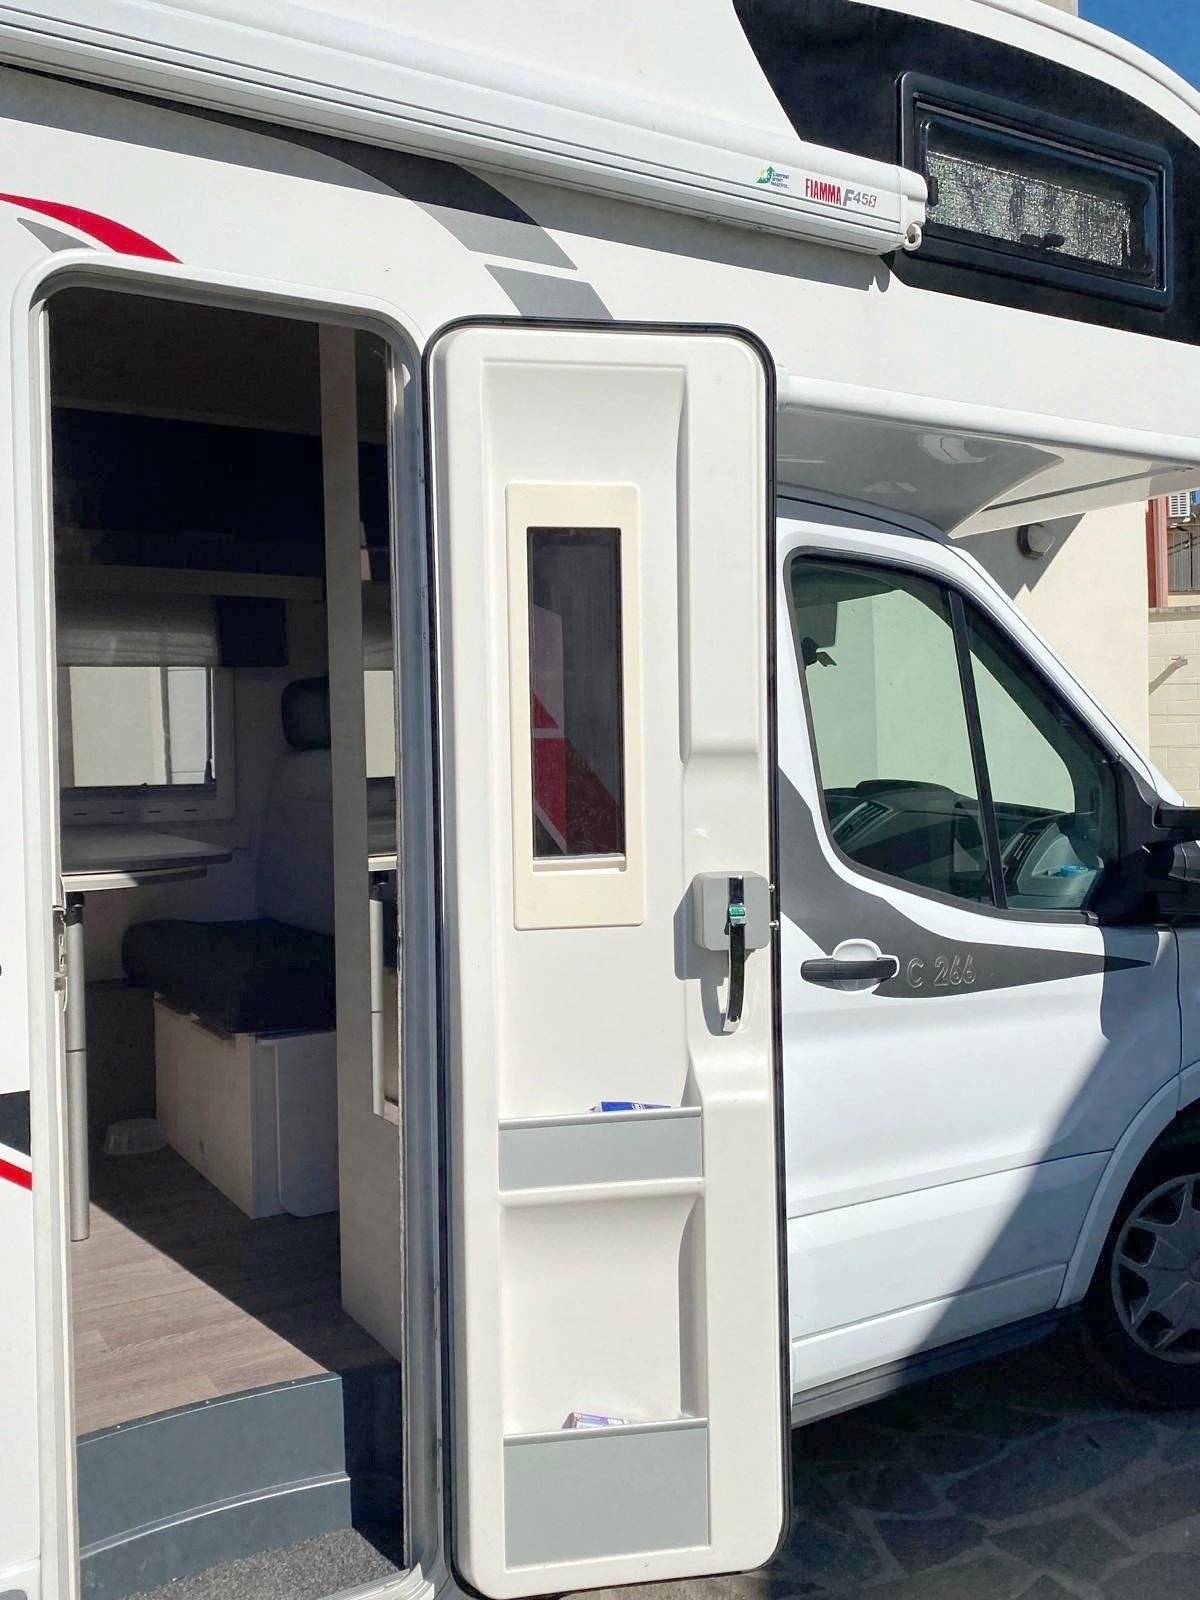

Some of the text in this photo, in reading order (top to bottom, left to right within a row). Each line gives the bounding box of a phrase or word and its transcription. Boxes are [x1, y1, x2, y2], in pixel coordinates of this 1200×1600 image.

[805, 177, 842, 206] FIAMMA
[906, 954, 976, 989] C 266
